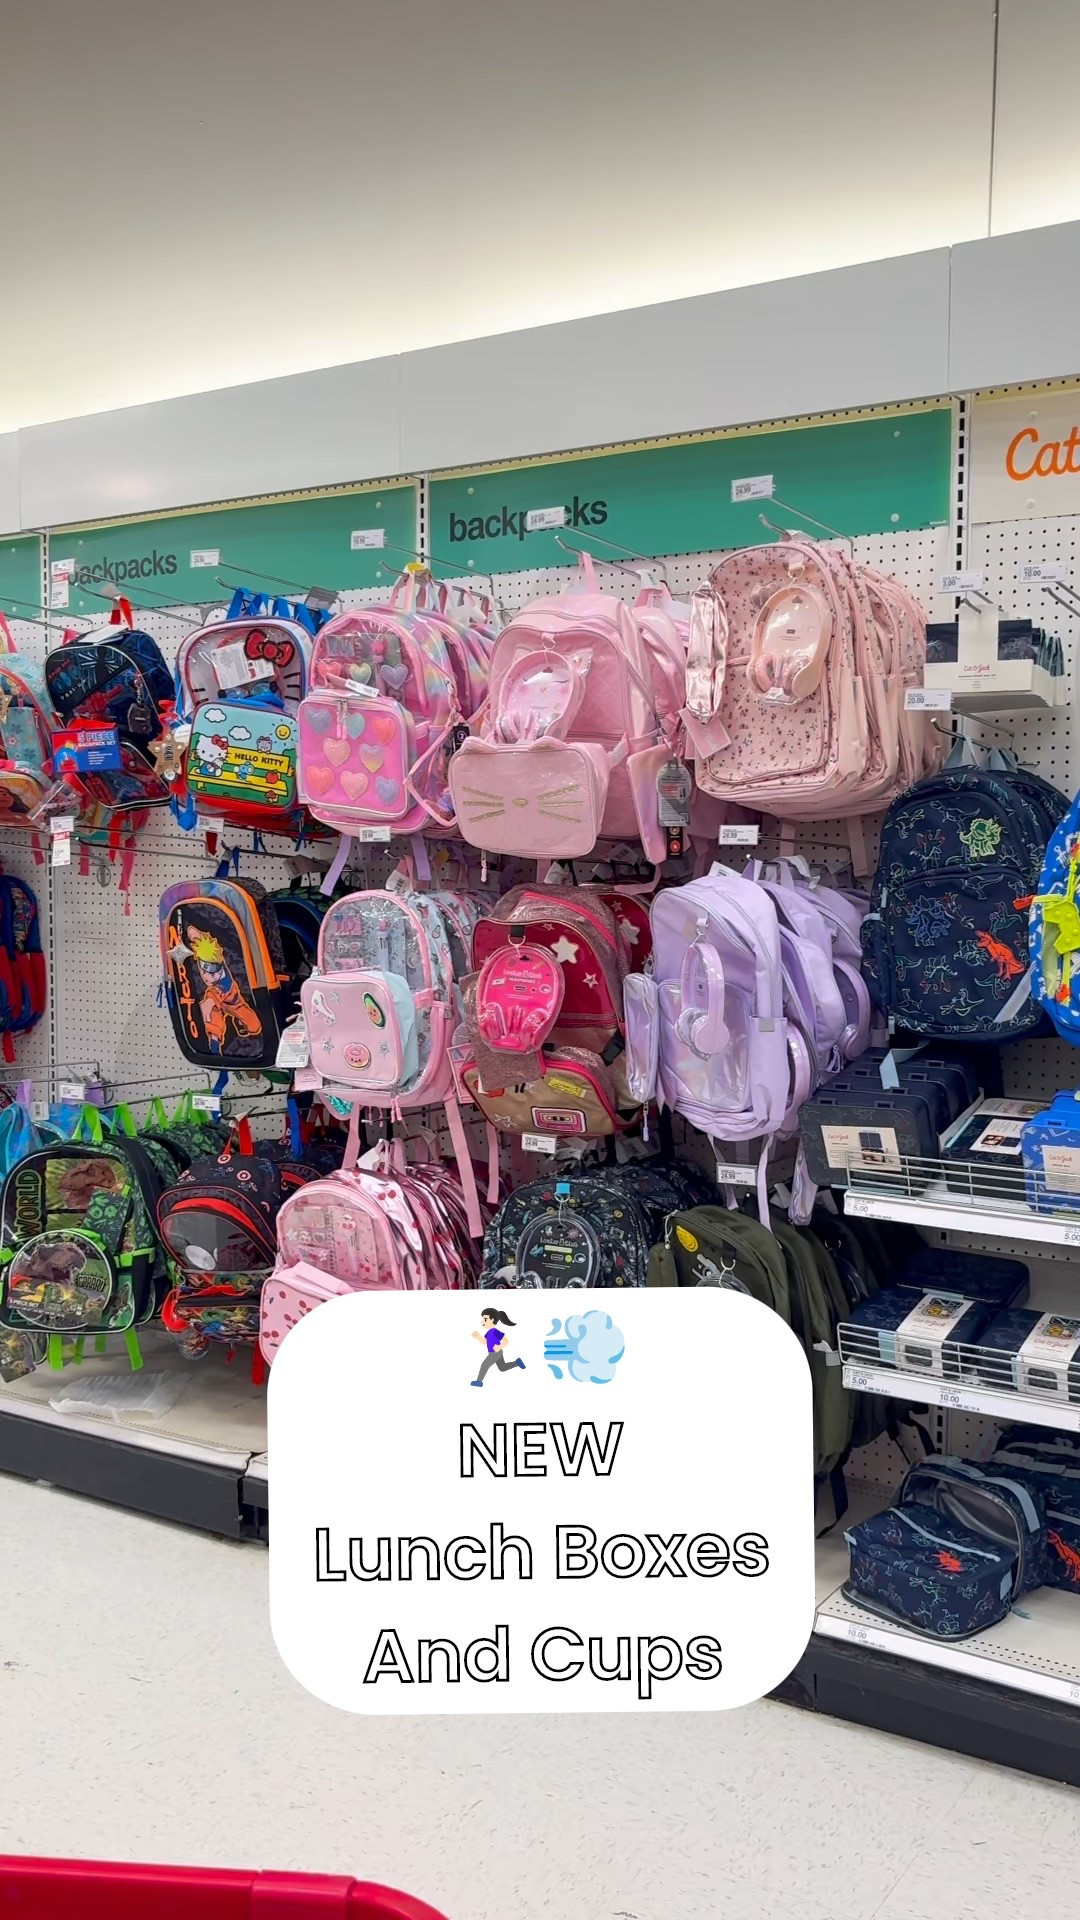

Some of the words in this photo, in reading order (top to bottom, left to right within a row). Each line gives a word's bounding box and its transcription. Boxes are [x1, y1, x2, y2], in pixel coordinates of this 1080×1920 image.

[1006, 426, 1080, 481] Cat
[86, 731, 115, 741] PIECE
[234, 752, 259, 763] HELLO
[261, 756, 284, 767] KITTY
[168, 925, 199, 1039] NRUTO
[16, 1169, 42, 1241] WORLD
[852, 1377, 868, 1386] 5.00
[940, 1394, 960, 1403] 10.00
[848, 1629, 867, 1639] 10.00
